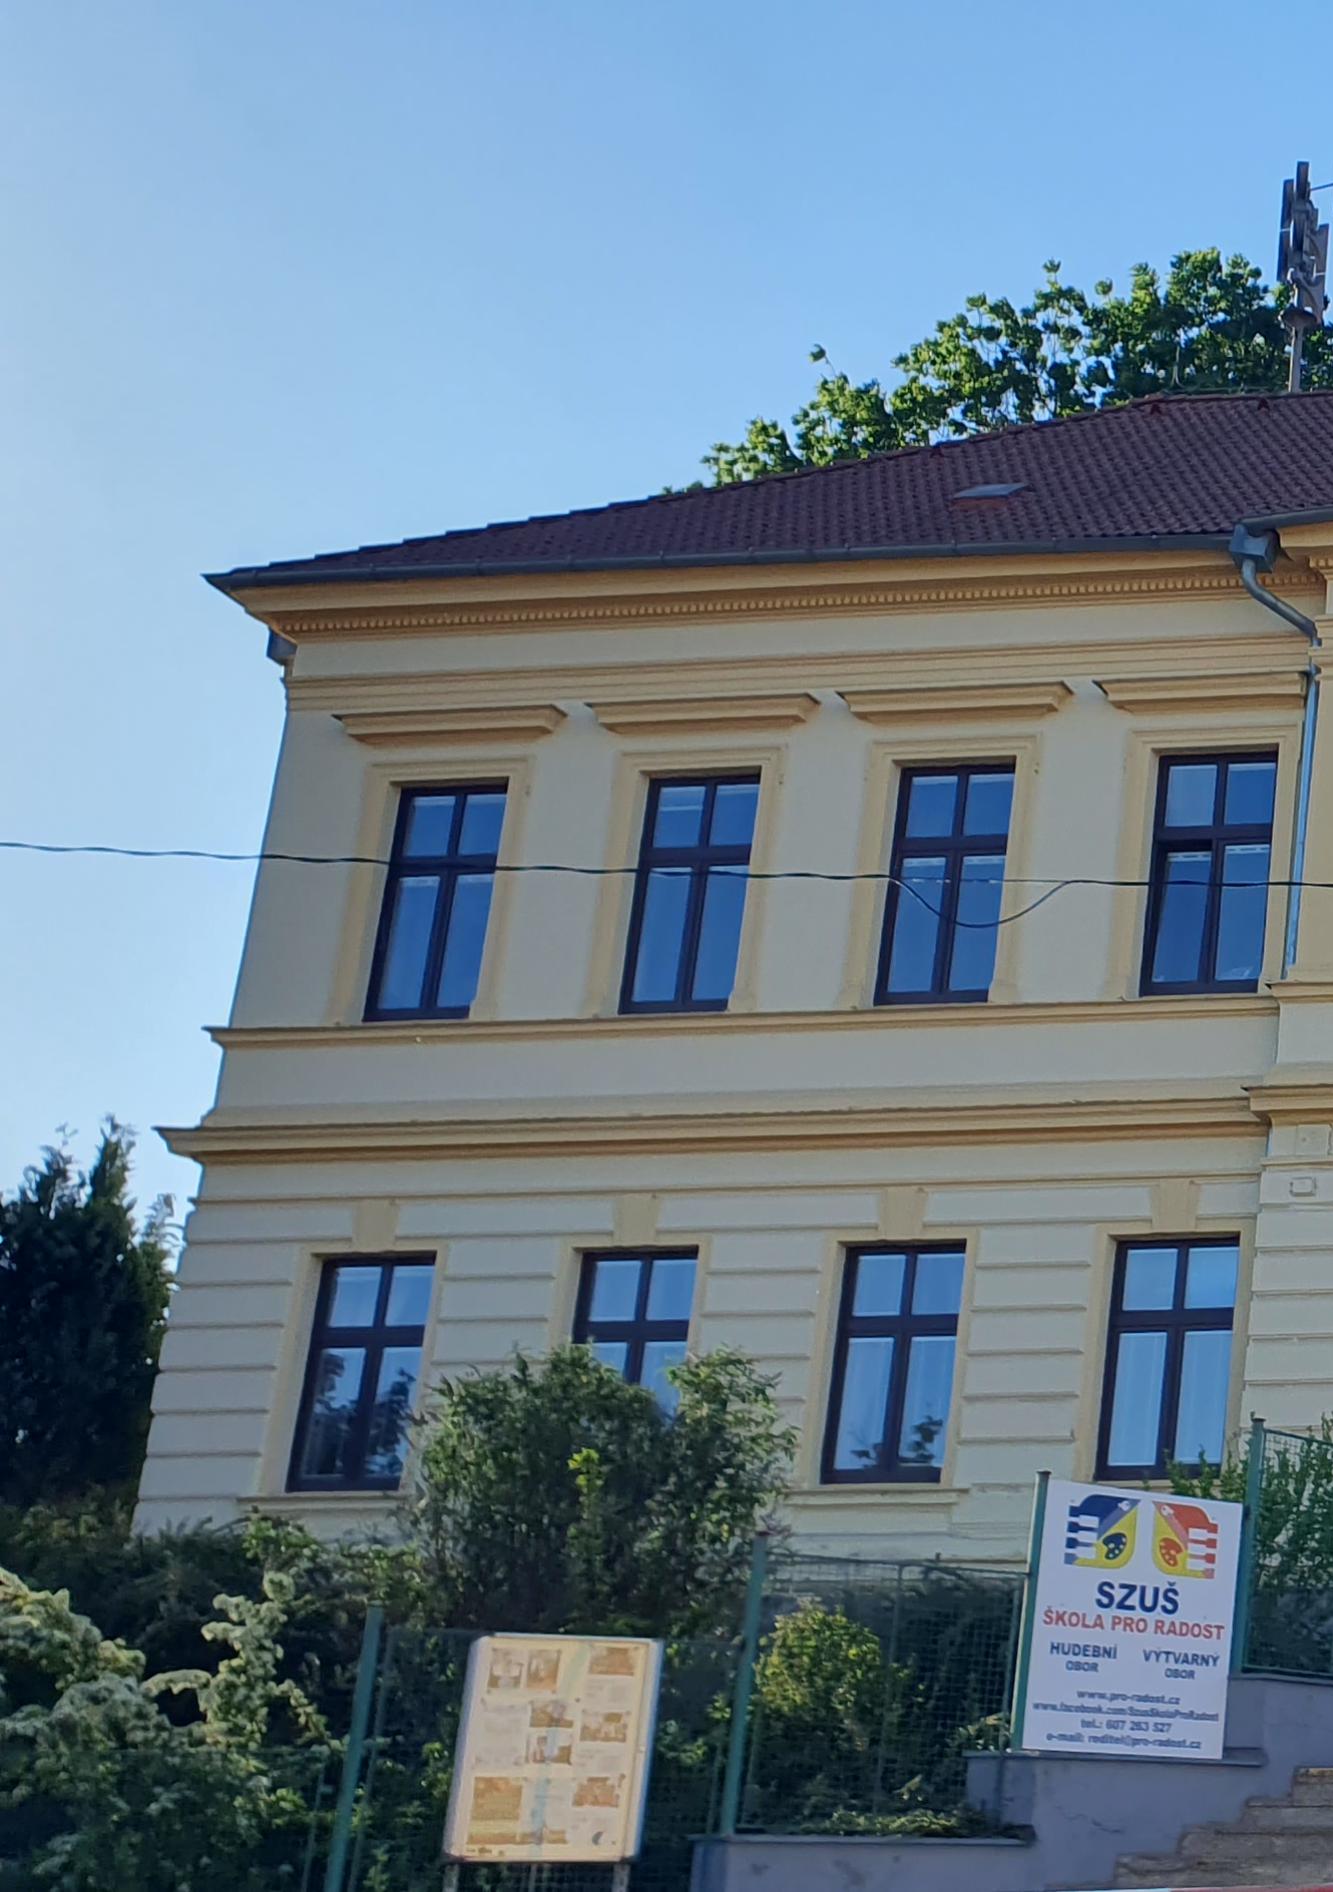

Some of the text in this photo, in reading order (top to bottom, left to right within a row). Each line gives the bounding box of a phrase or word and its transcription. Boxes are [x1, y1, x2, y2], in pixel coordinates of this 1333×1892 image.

[1095, 1581, 1180, 1615] SZUŠ
[1043, 1606, 1225, 1641] ŠKOLA PRO RADOST
[1050, 1641, 1118, 1660] HUDEBNÍ
[1143, 1647, 1220, 1667] VÝTVARNÝ
[1065, 1660, 1099, 1673] OBOR
[1164, 1668, 1196, 1680] OBOR
[1076, 1690, 1181, 1705] www.pro-radost.cz
